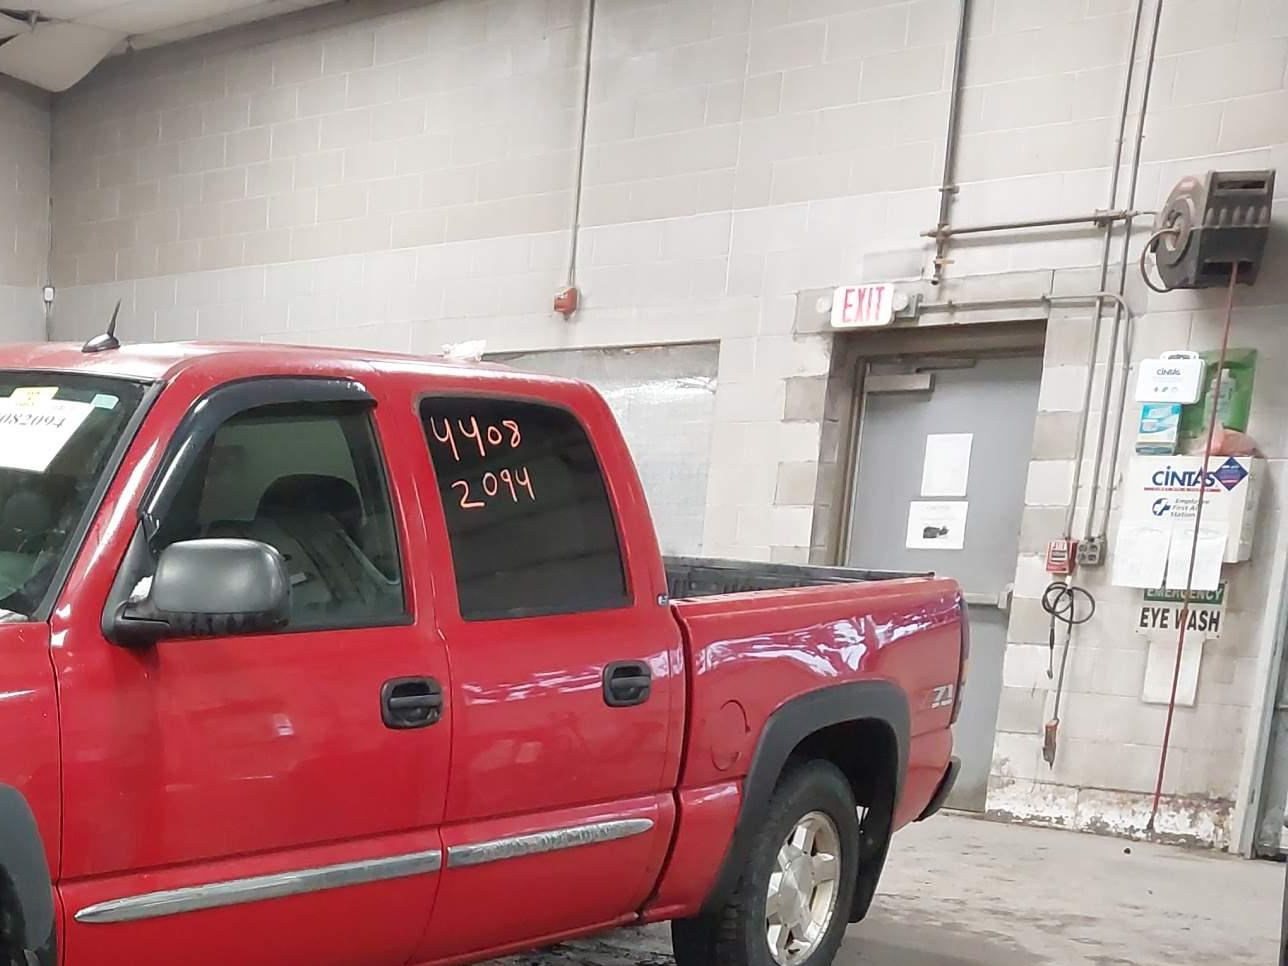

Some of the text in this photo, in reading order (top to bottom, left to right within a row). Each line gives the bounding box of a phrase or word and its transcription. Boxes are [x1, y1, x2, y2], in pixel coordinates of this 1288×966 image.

[841, 286, 886, 323] EXIT
[430, 416, 521, 461] 4408
[451, 466, 536, 508] 2094
[1140, 607, 1170, 629] EYE
